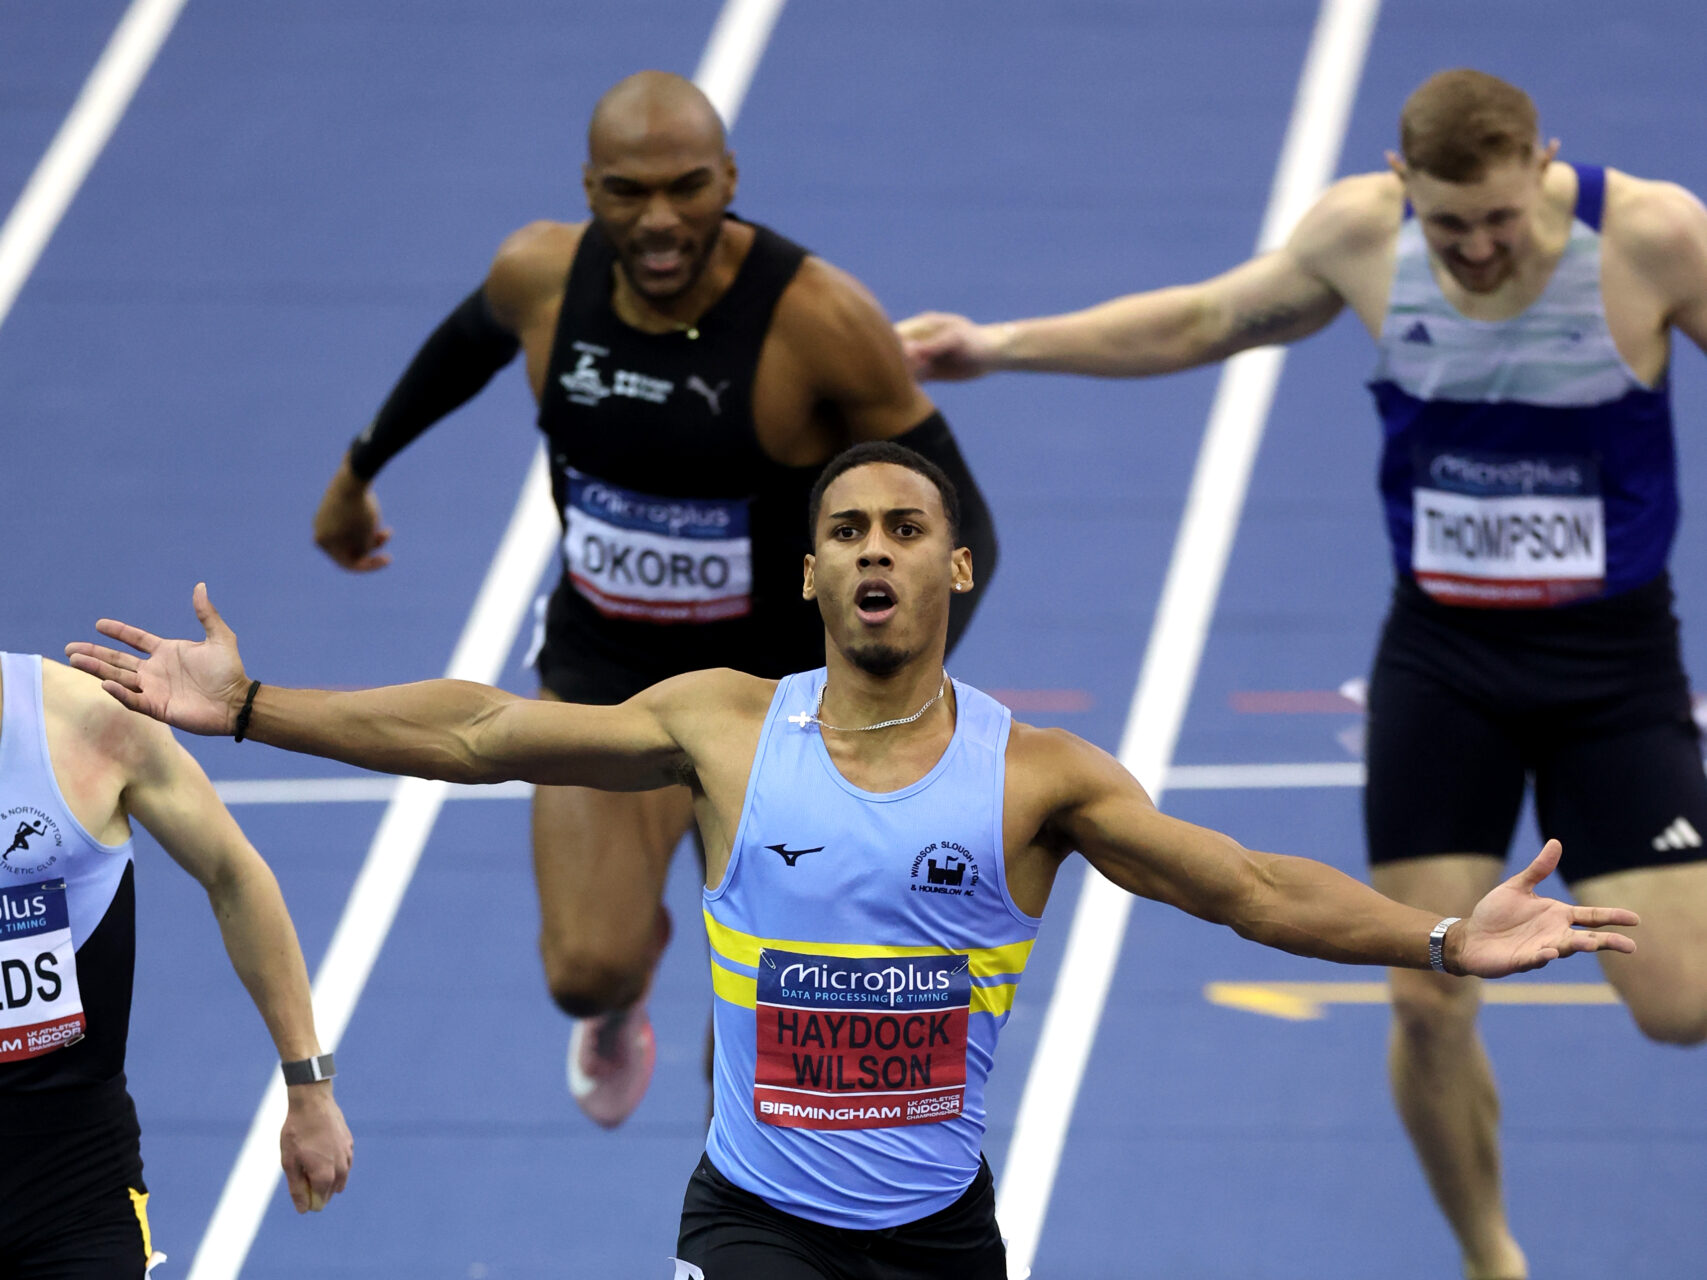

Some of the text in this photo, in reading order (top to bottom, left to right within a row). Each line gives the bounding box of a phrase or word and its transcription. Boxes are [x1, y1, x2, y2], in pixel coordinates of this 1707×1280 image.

[1425, 508, 1593, 560] THOMPSON
[583, 535, 730, 588] OKORO
[8, 806, 62, 847] NORTHAMPTON
[37, 856, 57, 872] CLUB
[911, 841, 979, 886] WINDSOR SLOUGH ETON
[919, 885, 962, 896] HOUNSLOW
[6, 917, 47, 932] TIMING
[780, 964, 950, 1007] Microplus
[782, 989, 948, 1003] DATA PROCESSING & TIMING
[777, 1012, 952, 1049] HAYDOCK
[792, 1053, 932, 1089] WILSON
[760, 1101, 901, 1120] BIRMINGHAM
[907, 1100, 960, 1115] INDOOR
[919, 1094, 960, 1104] ATHLETICS
